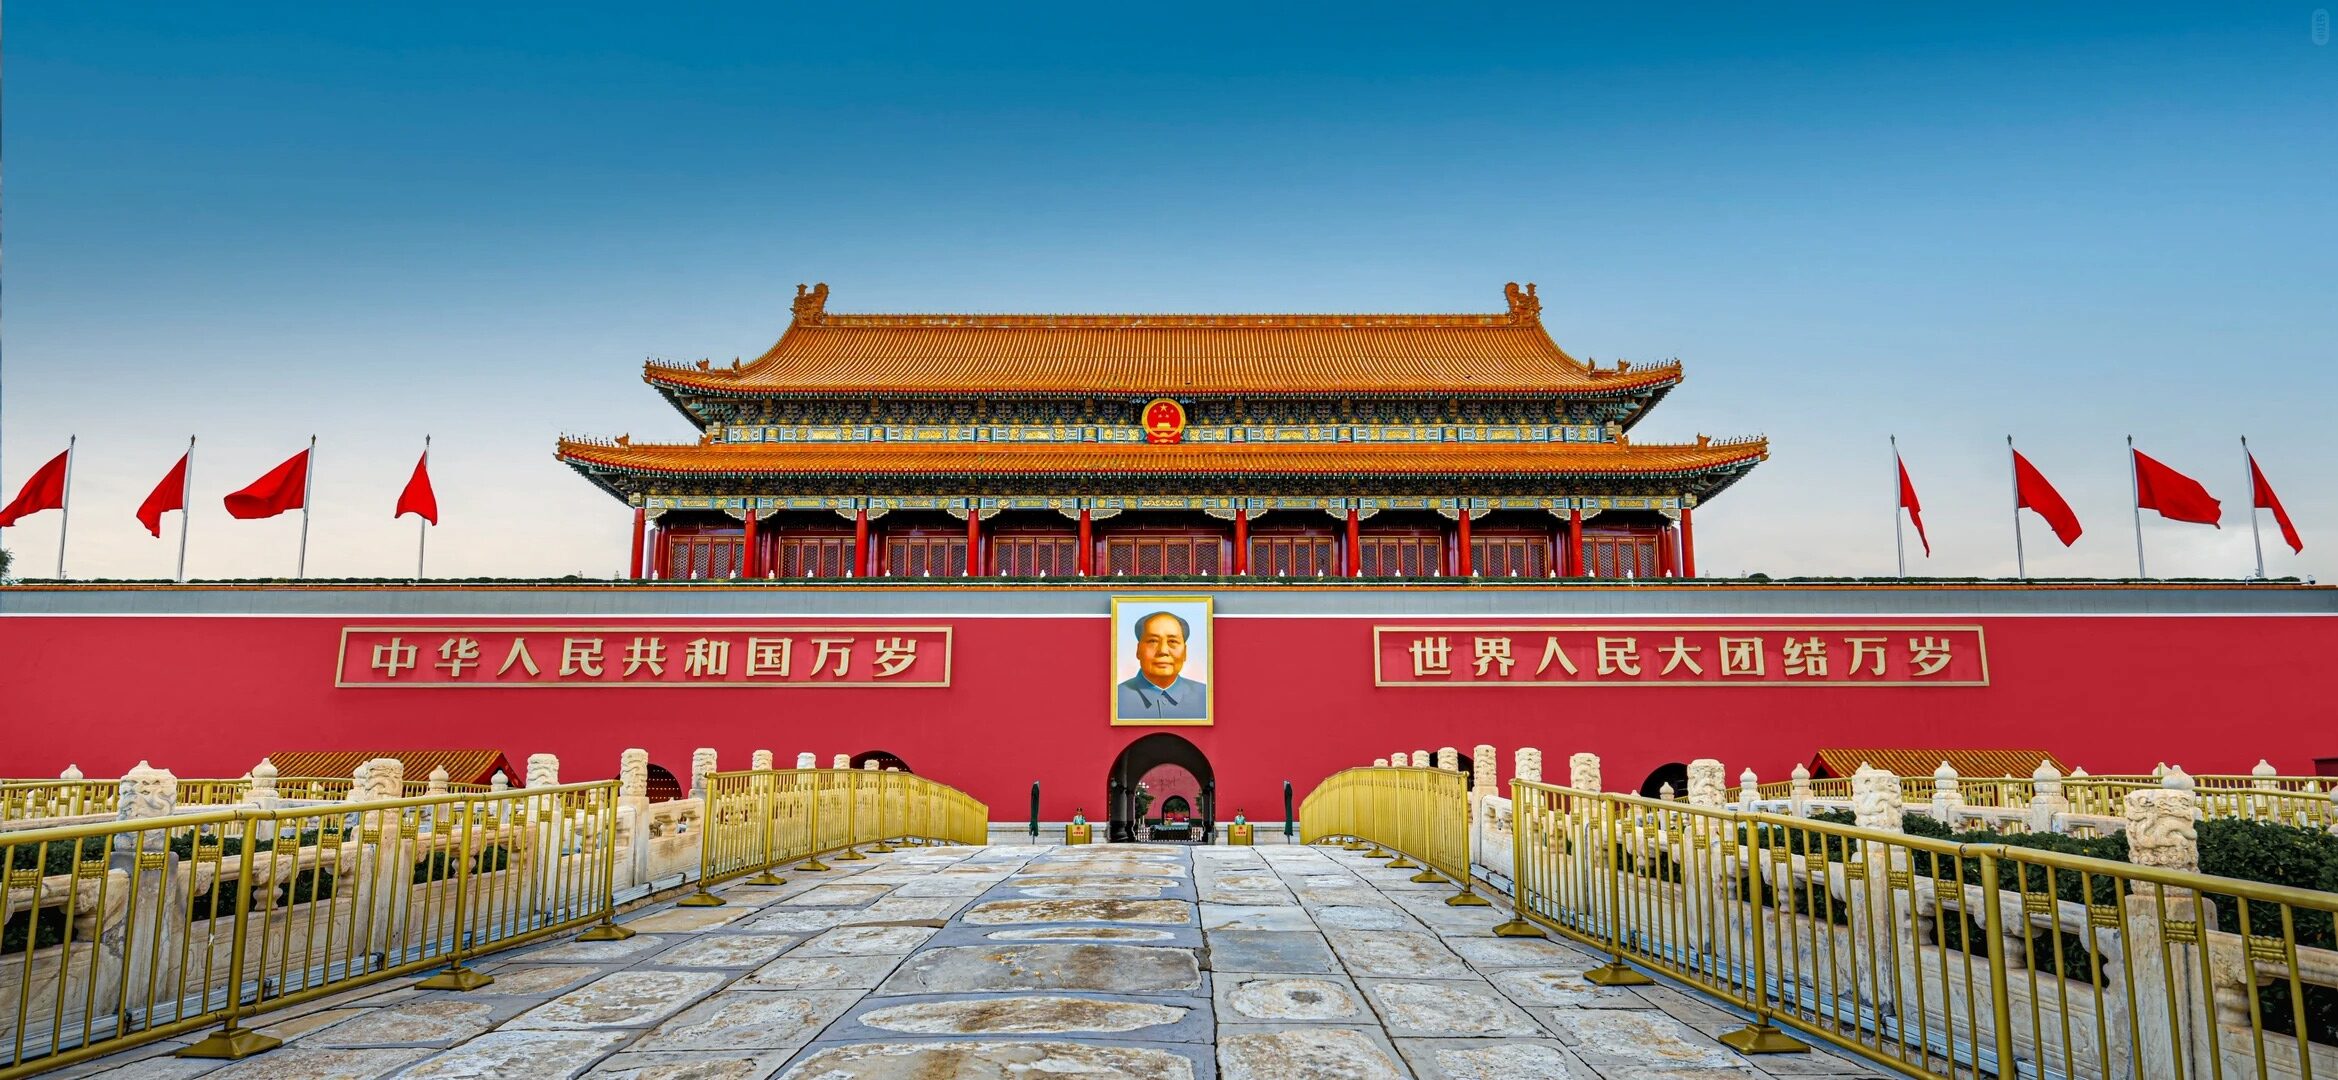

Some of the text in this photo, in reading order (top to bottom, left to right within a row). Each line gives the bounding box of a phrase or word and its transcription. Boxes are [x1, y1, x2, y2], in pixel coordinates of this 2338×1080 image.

[371, 637, 917, 677] 中华人民共和国万岁
[1408, 636, 1953, 677] 世界人民大团结万岁
